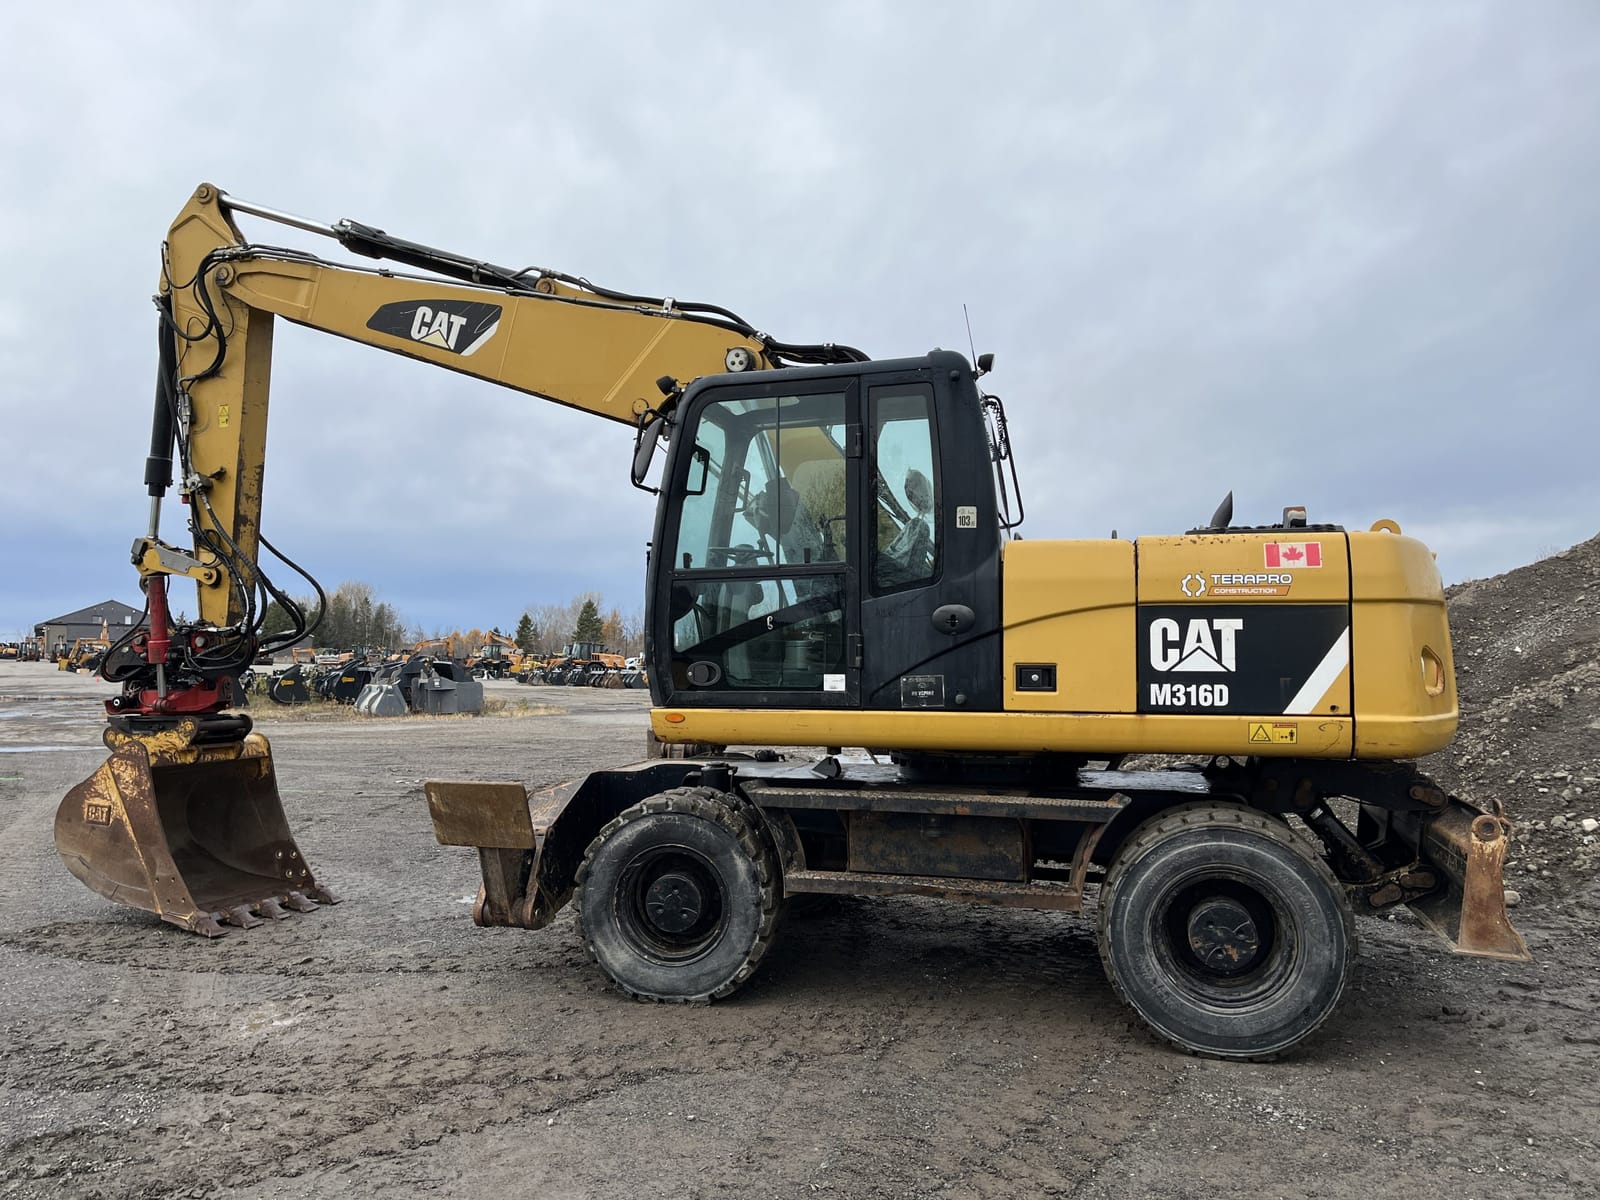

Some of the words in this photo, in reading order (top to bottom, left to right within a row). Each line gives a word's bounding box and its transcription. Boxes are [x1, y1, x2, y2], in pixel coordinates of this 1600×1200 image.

[410, 306, 467, 349] CAT
[958, 515, 971, 527] 103
[1210, 574, 1292, 584] TERAPRO
[1149, 618, 1243, 672] CAT
[1150, 684, 1229, 706] M316D
